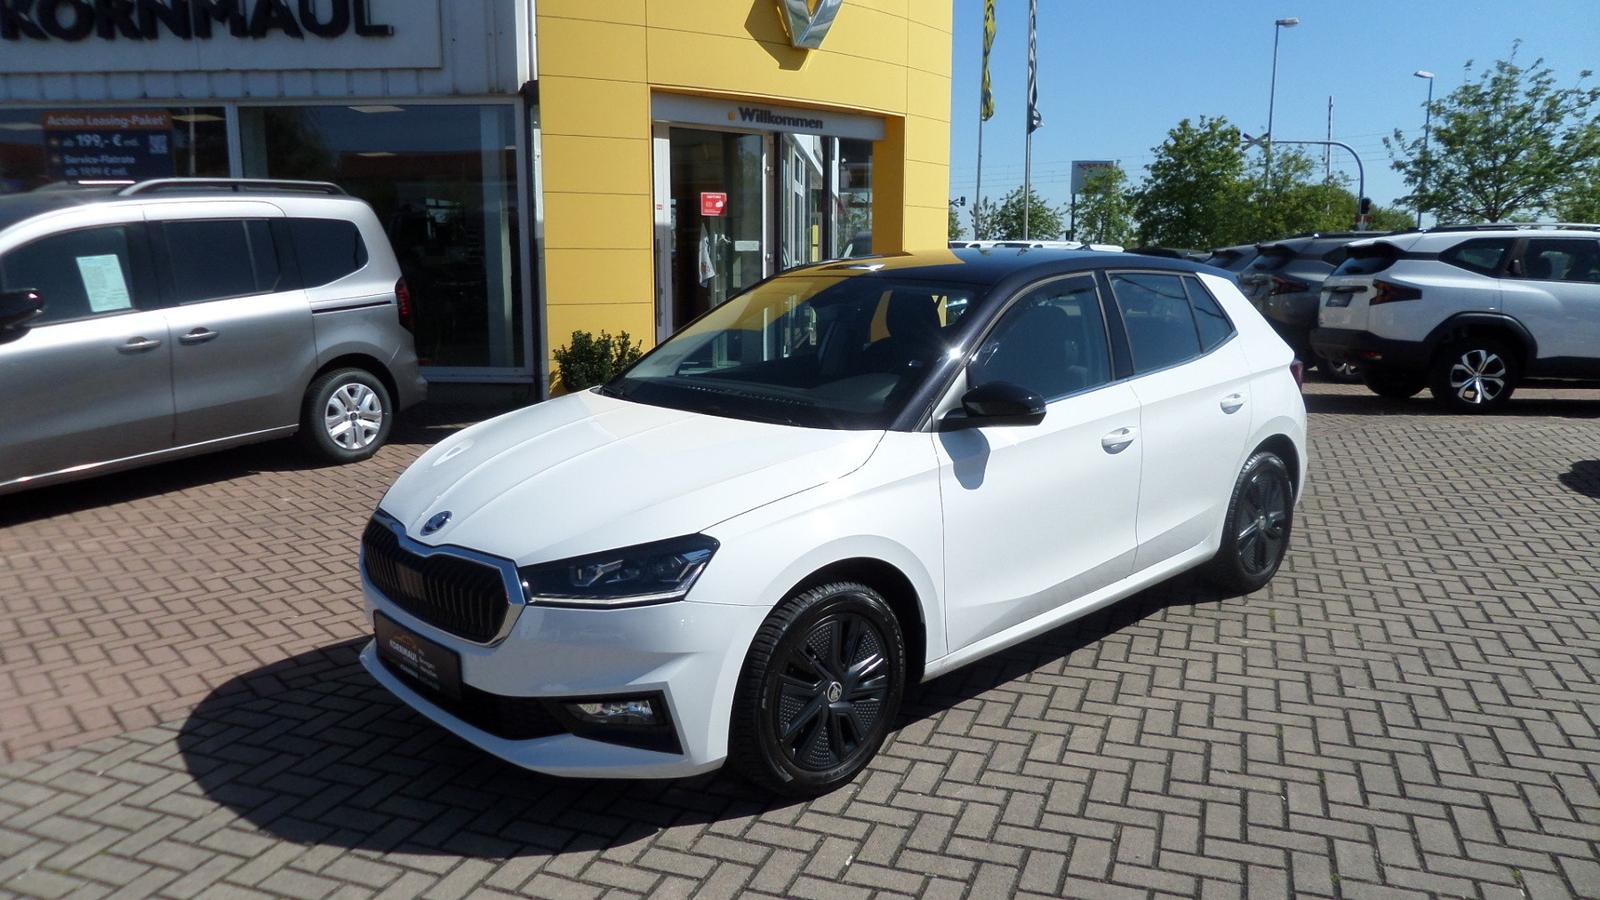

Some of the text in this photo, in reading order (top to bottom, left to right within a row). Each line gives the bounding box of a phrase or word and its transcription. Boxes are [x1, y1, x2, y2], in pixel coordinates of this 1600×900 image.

[0, 0, 394, 41] KORNMAUL
[48, 115, 84, 126] Action
[738, 106, 823, 129] Willkommen
